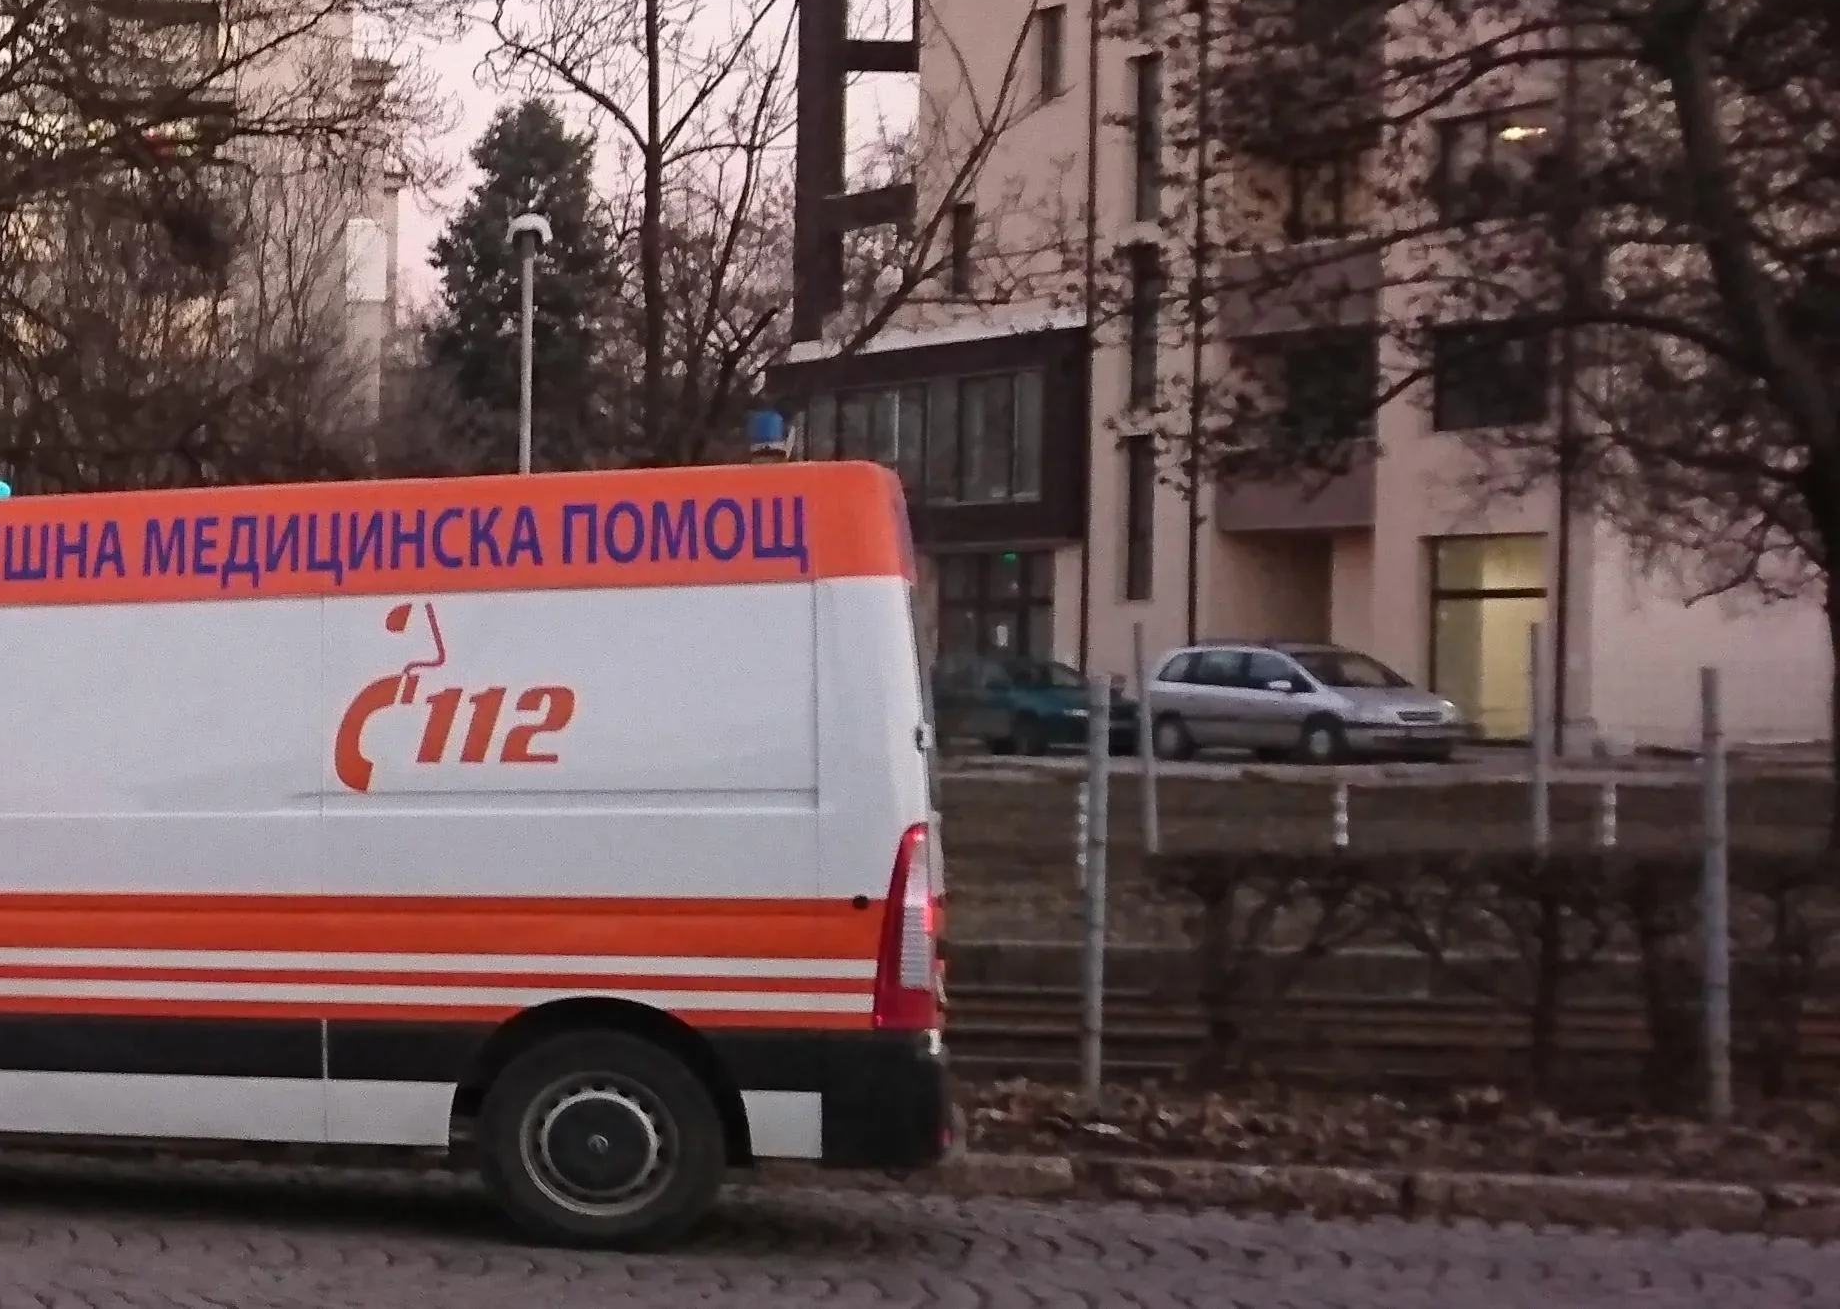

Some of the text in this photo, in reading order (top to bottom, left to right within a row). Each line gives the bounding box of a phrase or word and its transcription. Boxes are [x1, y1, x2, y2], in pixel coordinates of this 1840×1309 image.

[142, 504, 544, 589] МЕДИЦИНСКА
[562, 495, 809, 574] ПОМОЩ
[416, 686, 576, 764] 112
